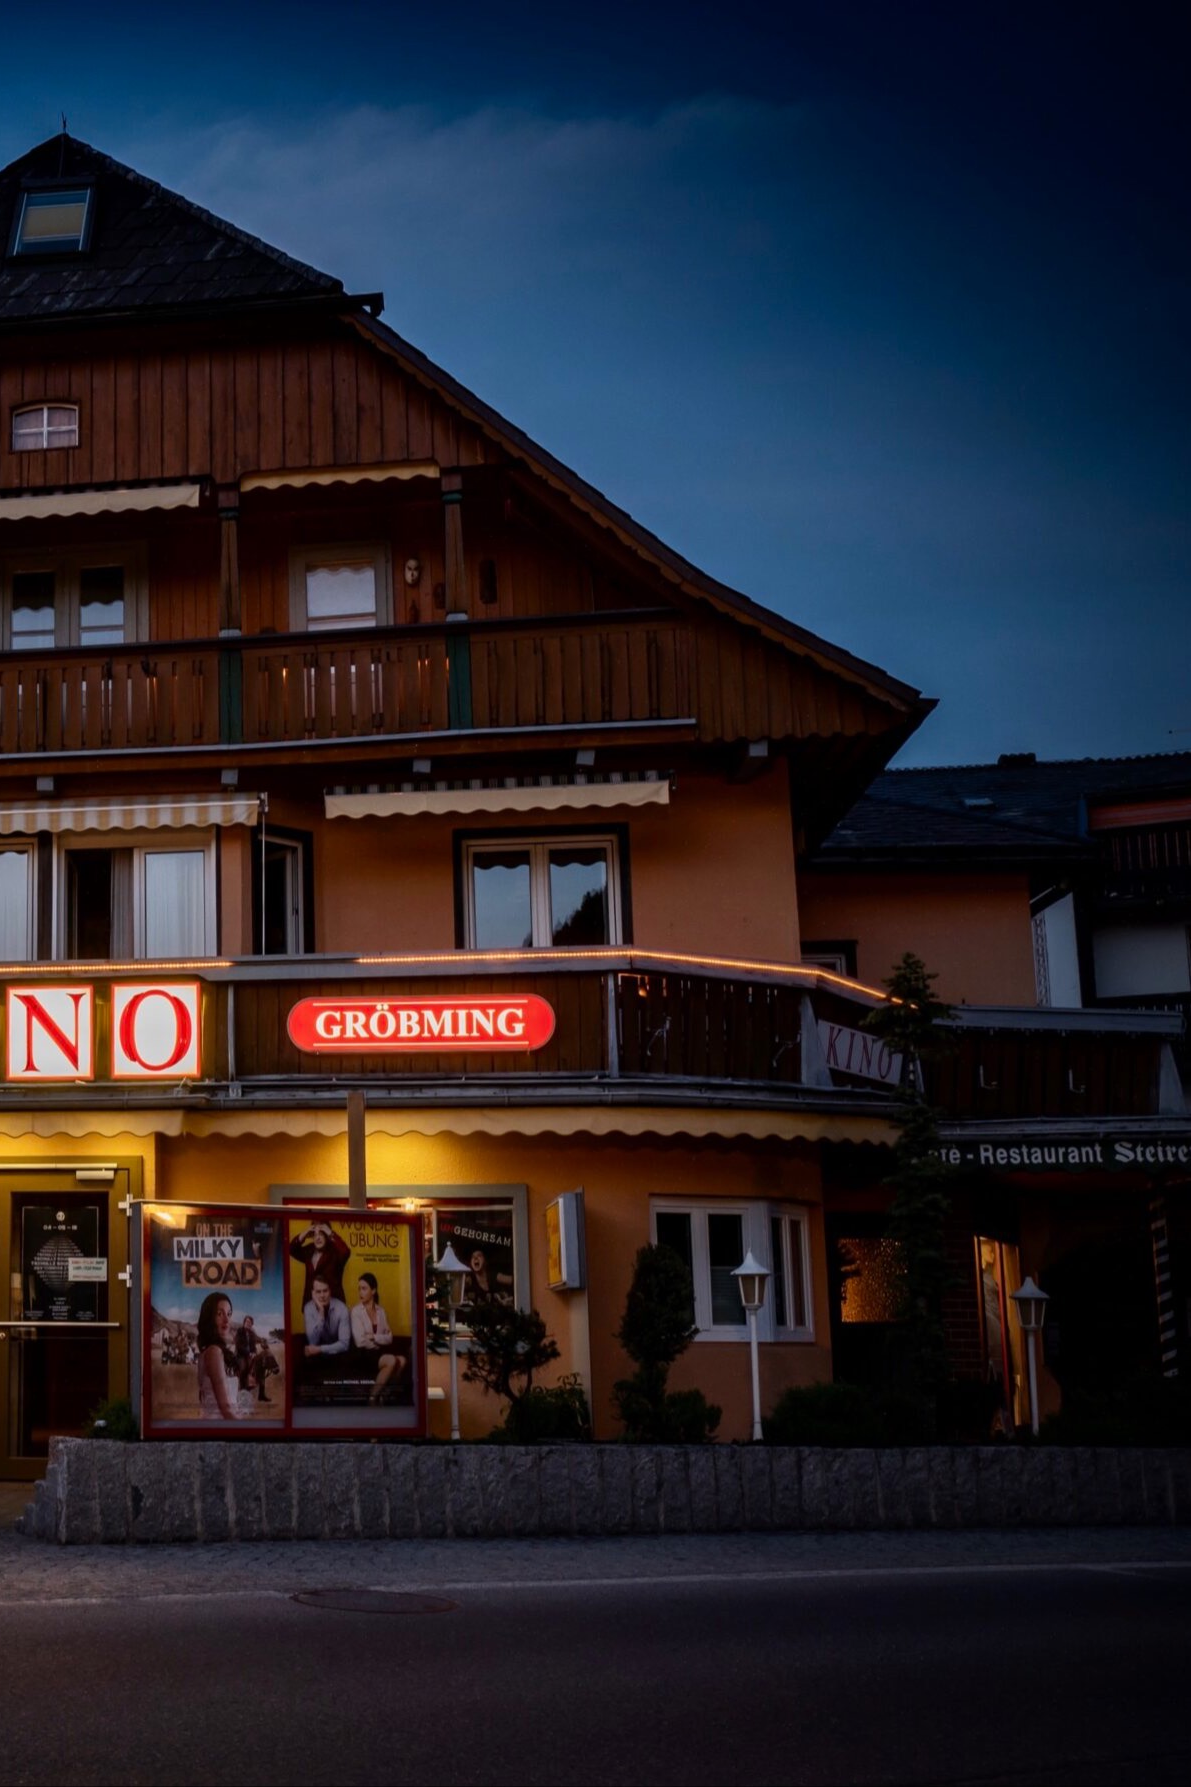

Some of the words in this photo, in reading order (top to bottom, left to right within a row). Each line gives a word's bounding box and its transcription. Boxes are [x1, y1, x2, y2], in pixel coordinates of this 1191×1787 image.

[315, 1003, 526, 1038] GRÖBMING
[826, 1025, 893, 1080] KINO
[979, 1143, 1103, 1165] Restaurant
[1113, 1141, 1191, 1163] Steire
[196, 1223, 209, 1237] ON
[212, 1223, 234, 1237] THE
[349, 1231, 399, 1249] ÜBUNG
[176, 1239, 242, 1258] MILKY
[184, 1261, 259, 1285] ROAD
